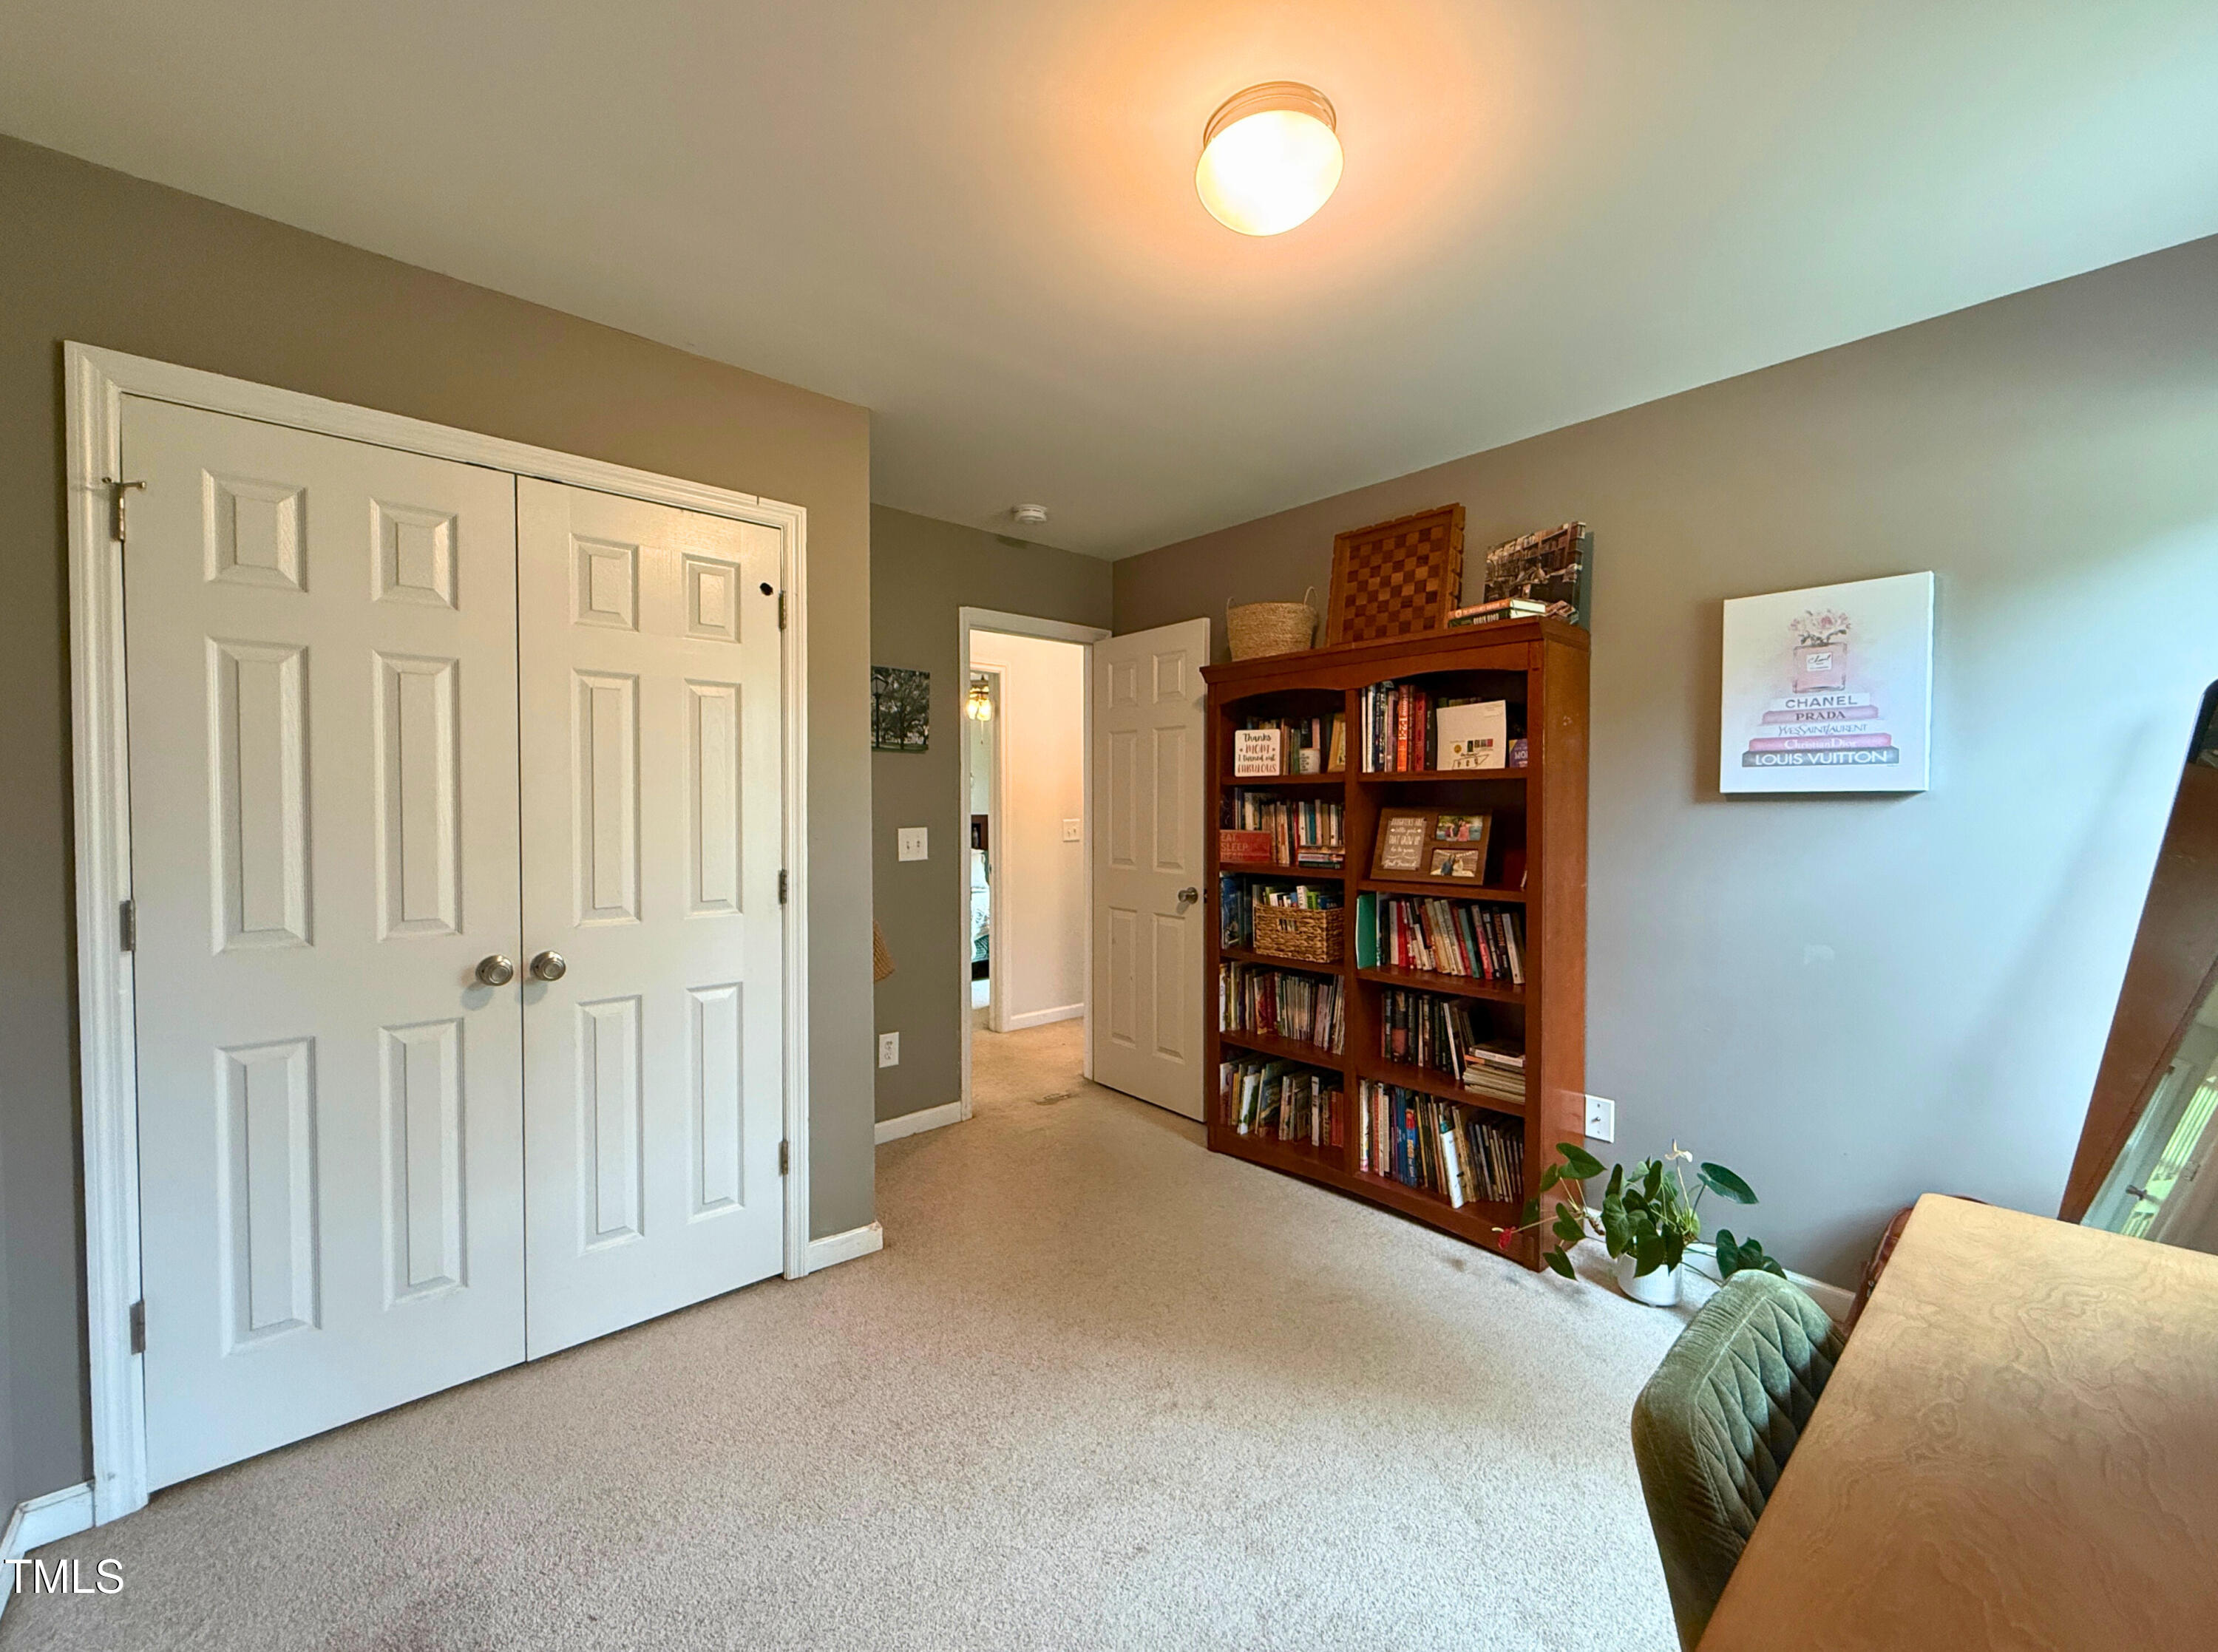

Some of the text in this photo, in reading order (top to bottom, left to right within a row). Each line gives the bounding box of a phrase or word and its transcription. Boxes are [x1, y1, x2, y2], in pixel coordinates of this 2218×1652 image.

[1785, 696, 1857, 708] CHANEL
[1796, 711, 1845, 721] PRADA
[1243, 733, 1272, 742] Thanks
[1243, 754, 1264, 762] turned
[1756, 751, 1887, 765] LOUIS VUITTON
[1220, 843, 1249, 852] SLEEP
